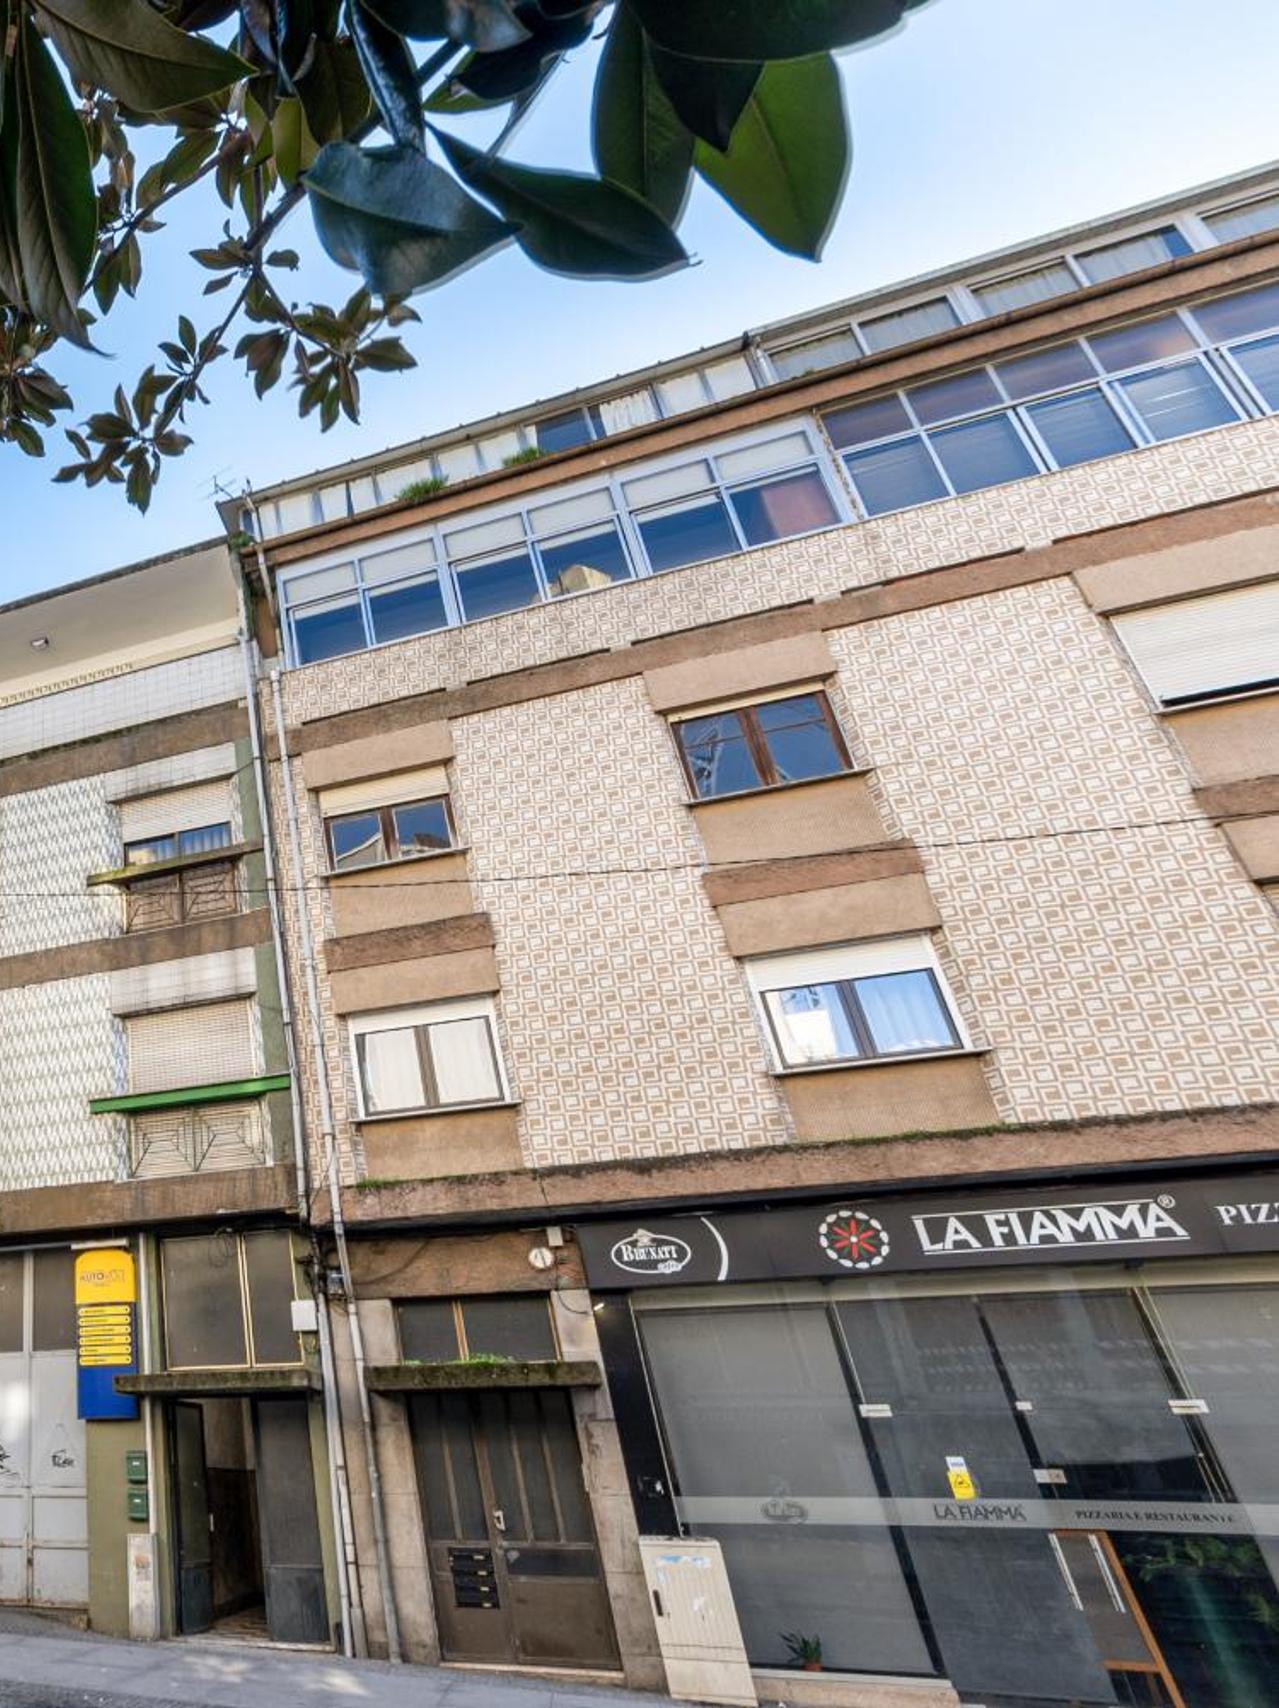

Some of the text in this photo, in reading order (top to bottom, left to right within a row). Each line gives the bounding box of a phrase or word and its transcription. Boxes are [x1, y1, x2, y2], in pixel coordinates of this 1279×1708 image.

[913, 1202, 1190, 1251] LA FIAMMA
[934, 1503, 1027, 1520] LA FIAMMA
